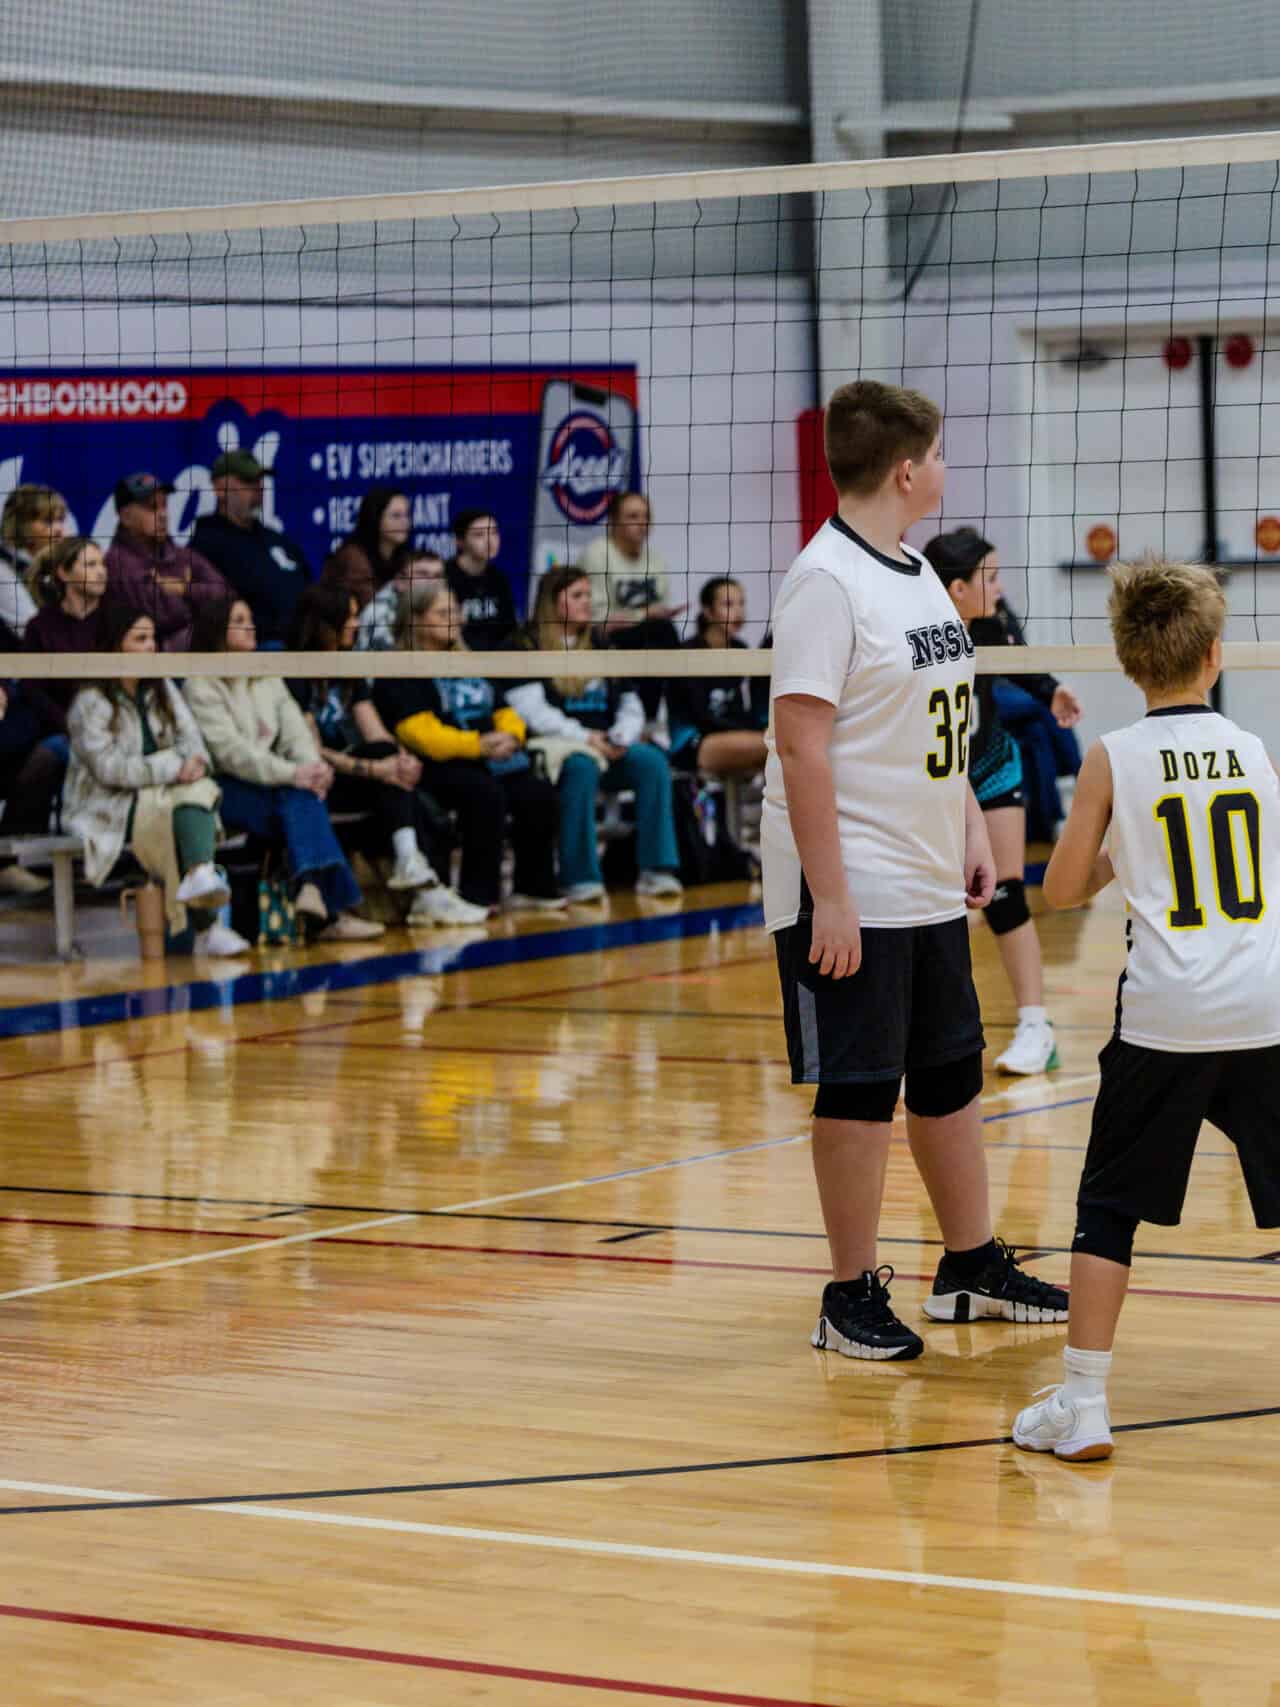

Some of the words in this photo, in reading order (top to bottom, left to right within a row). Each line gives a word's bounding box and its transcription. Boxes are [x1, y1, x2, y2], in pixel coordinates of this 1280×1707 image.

[326, 443, 352, 479] EV
[357, 440, 513, 475] SUPERCHARGERS
[926, 681, 970, 780] 32
[1159, 748, 1246, 782] DOZA
[1153, 790, 1266, 930] 10
